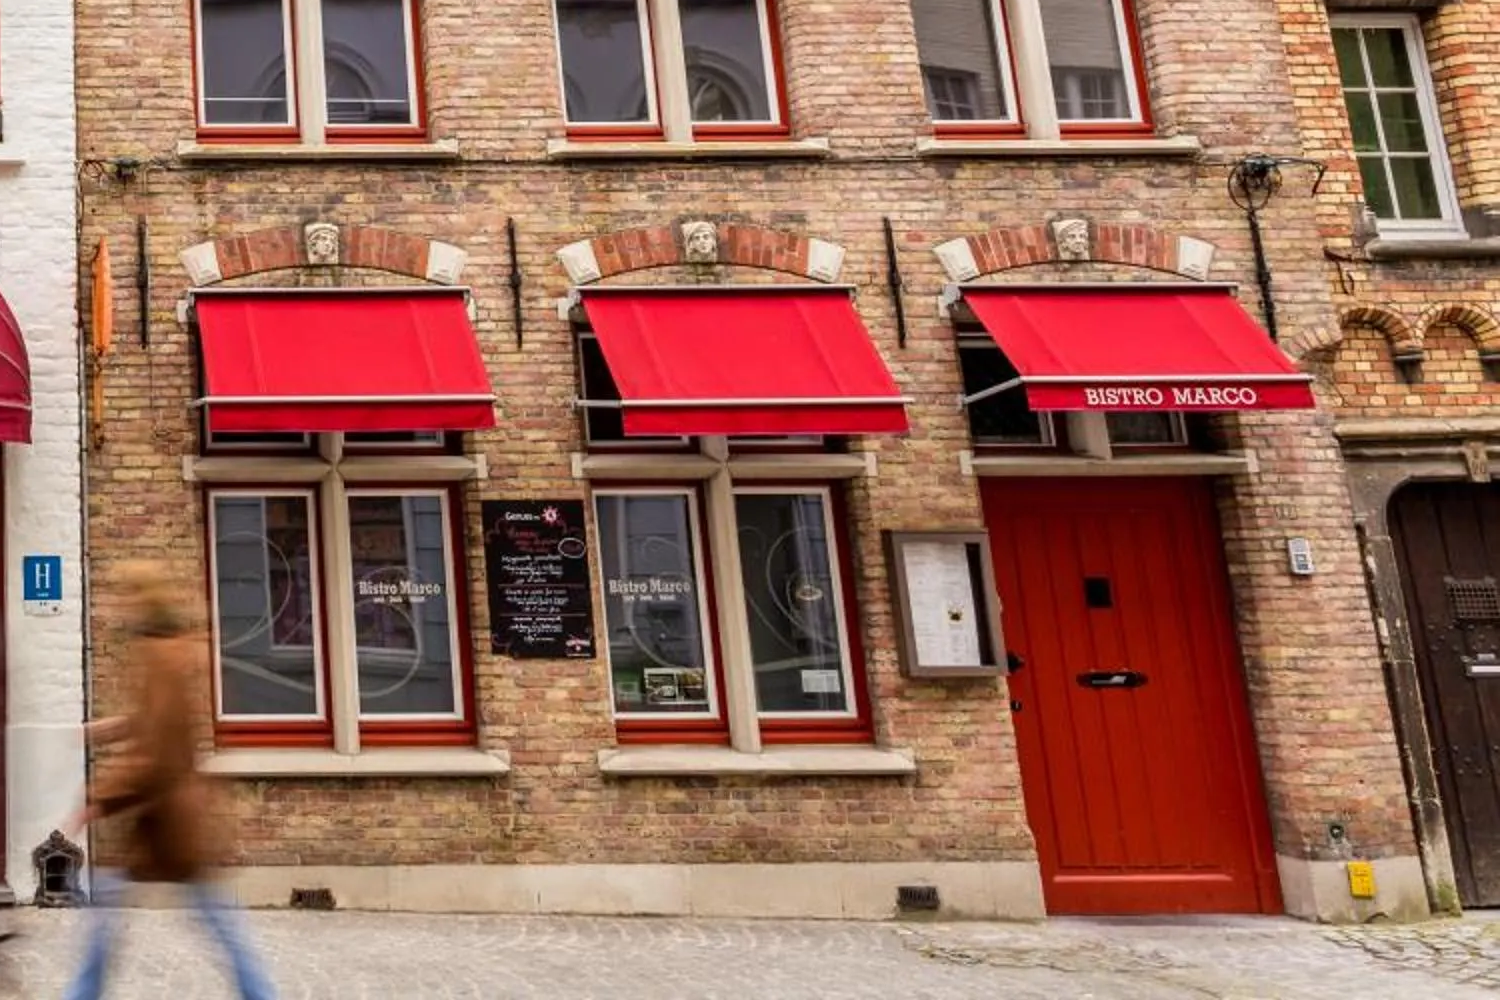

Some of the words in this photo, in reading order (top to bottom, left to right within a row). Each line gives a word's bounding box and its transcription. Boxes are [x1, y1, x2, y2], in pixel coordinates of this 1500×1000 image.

[1084, 387, 1163, 405] BISTRO
[1171, 386, 1257, 405] MARCO
[35, 563, 51, 589] H
[358, 581, 398, 595] Bistro
[400, 581, 441, 595] Marco
[608, 579, 648, 593] Bistro
[649, 577, 691, 593] Marco
